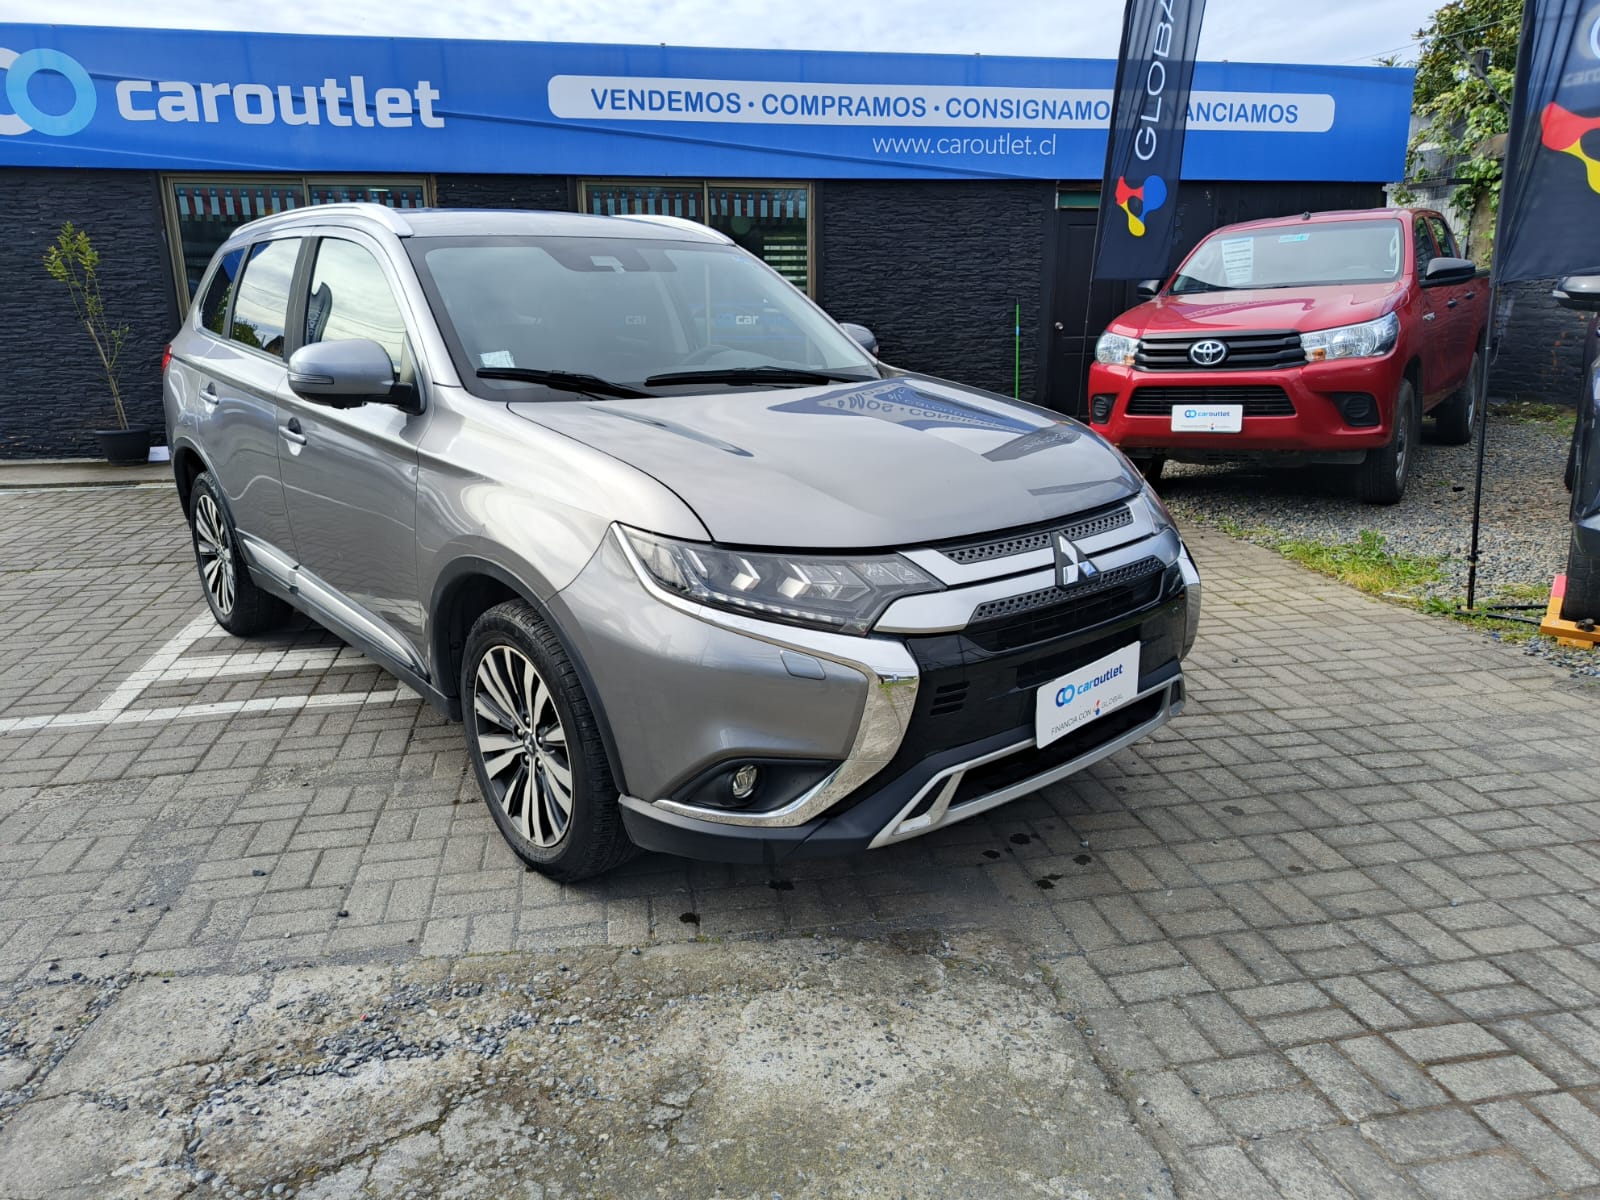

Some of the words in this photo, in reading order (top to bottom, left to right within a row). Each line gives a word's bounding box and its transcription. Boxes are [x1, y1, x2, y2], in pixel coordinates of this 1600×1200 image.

[115, 76, 445, 128] caroutlet
[590, 87, 742, 114] VENDEMOS
[761, 93, 927, 118] COMPRAMOS
[945, 97, 1112, 122] CONSIGNAMO
[1170, 102, 1299, 124] ANCIAMOS
[872, 132, 1057, 156] www.caroutlet.cl
[1077, 664, 1124, 695] caroutlet
[1078, 707, 1092, 721] CON
